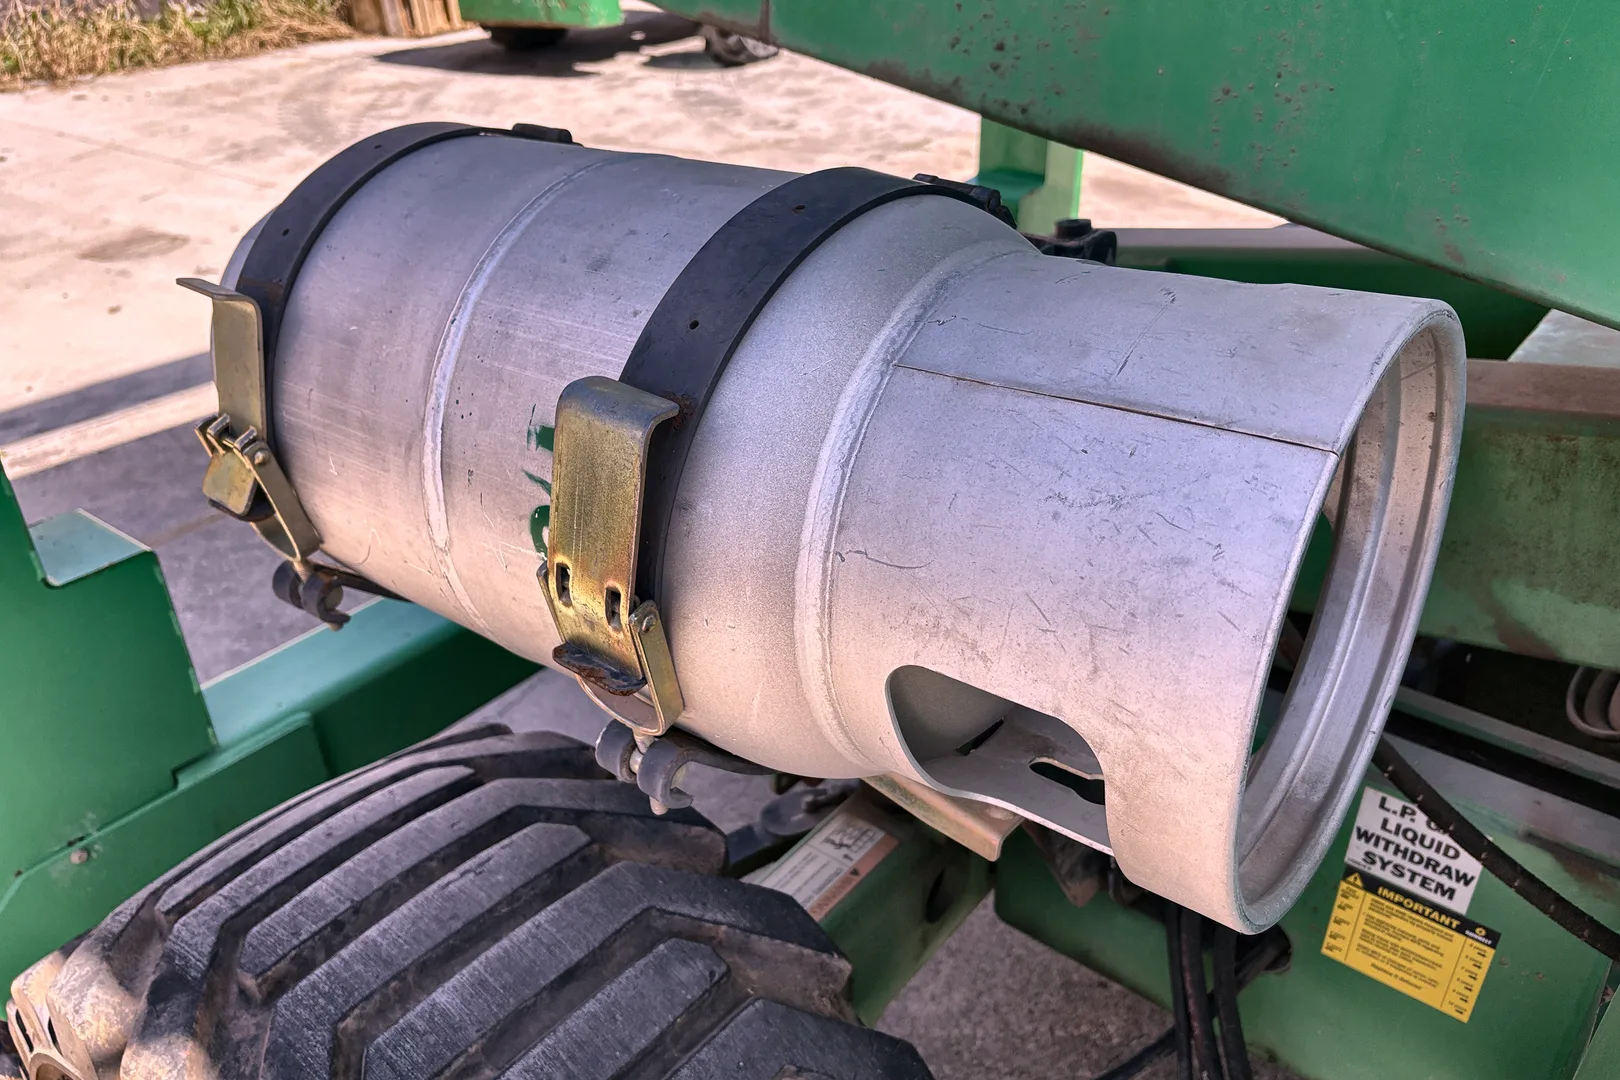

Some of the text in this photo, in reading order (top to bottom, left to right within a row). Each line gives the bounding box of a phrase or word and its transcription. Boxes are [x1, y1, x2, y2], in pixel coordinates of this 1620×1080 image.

[1378, 796, 1417, 823] L.P.
[1355, 826, 1476, 887] WITHDRAW
[1381, 817, 1461, 860] LIQUID
[1362, 850, 1457, 901] SYSTEM
[1377, 886, 1461, 930] IMPORTANT
